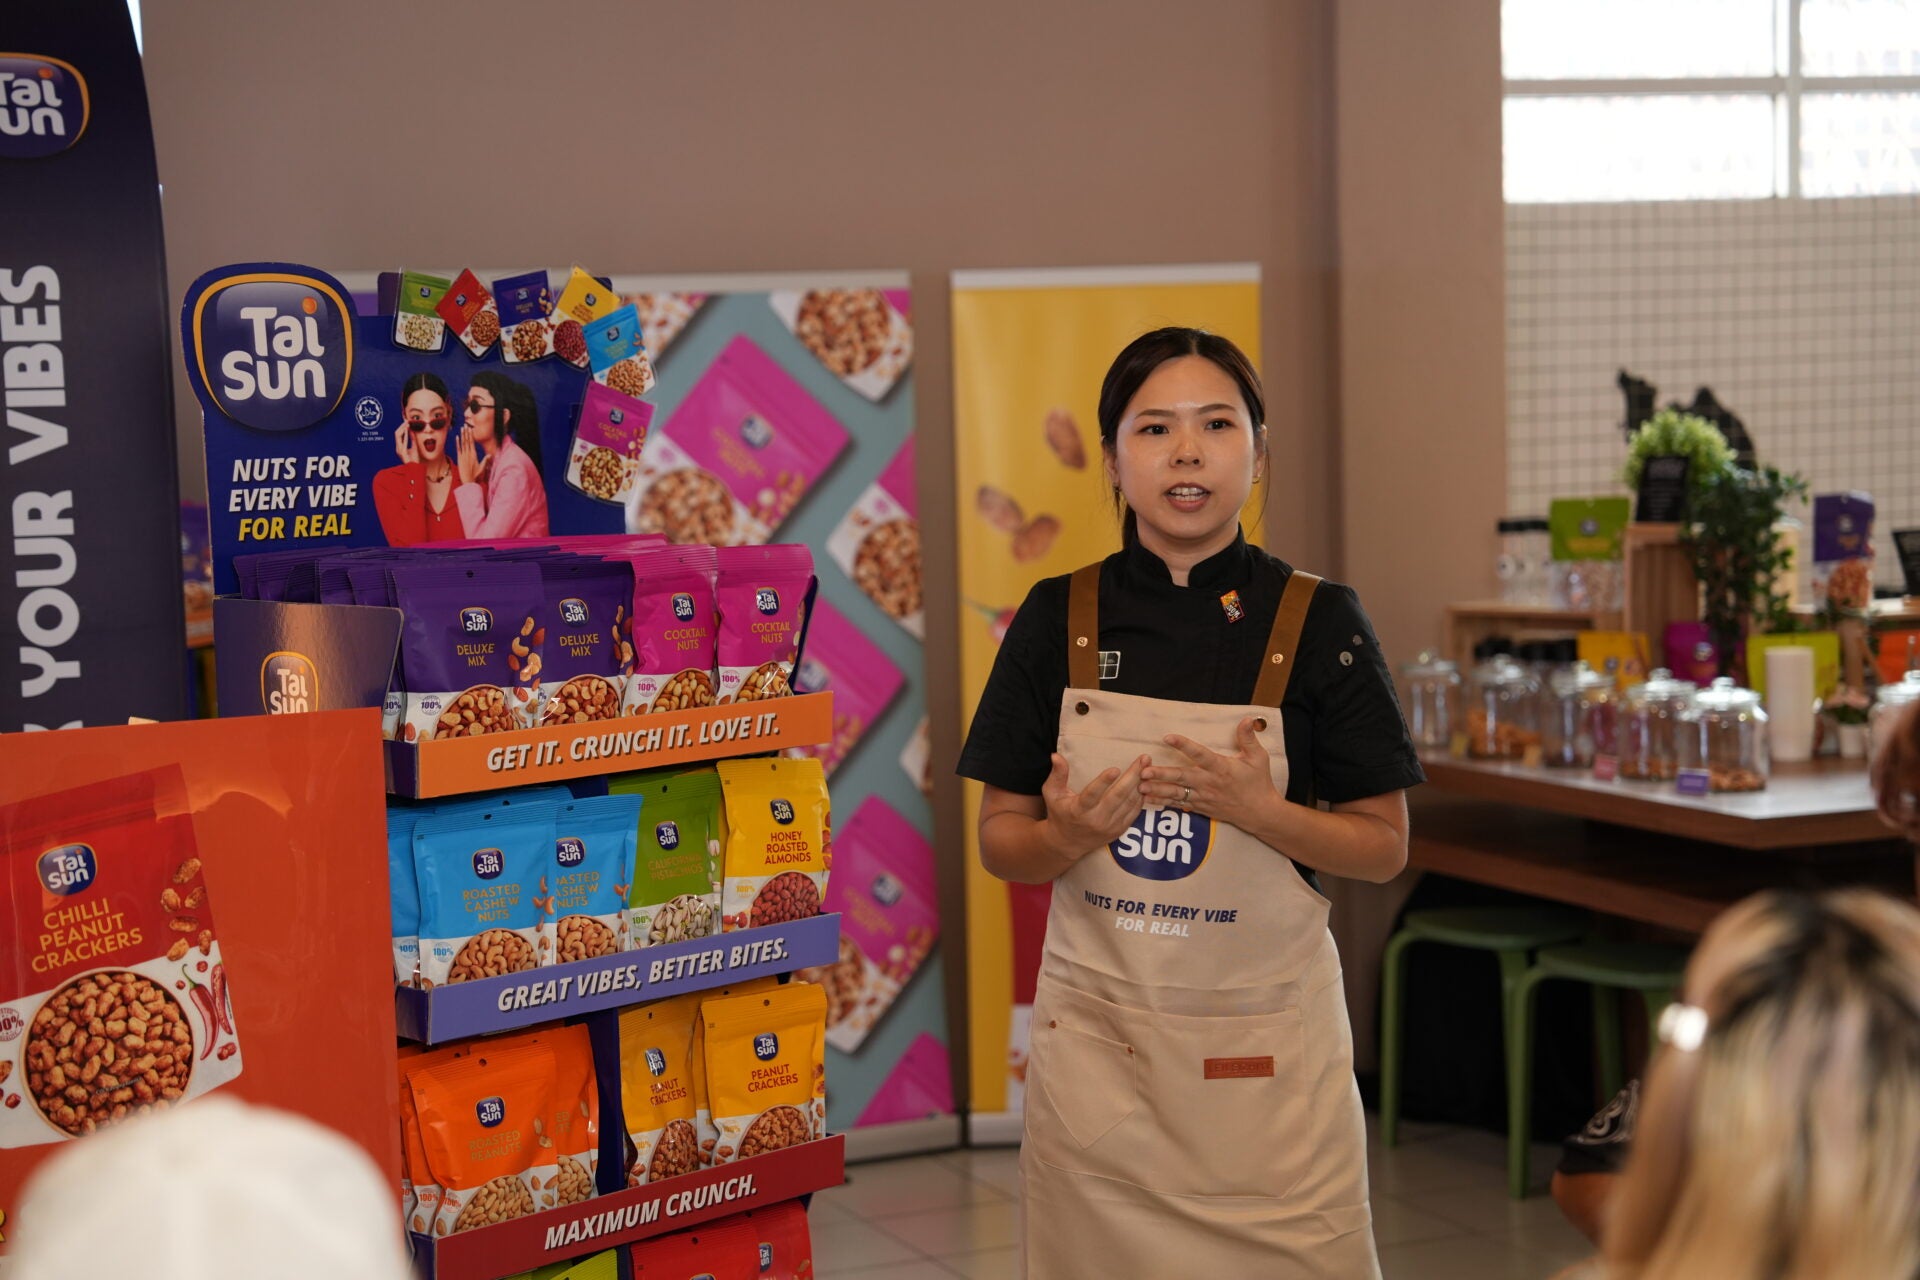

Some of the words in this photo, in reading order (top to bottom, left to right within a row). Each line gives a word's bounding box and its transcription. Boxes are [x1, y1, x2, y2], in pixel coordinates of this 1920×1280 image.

[0, 107, 66, 136] un
[240, 296, 325, 358] Tai
[0, 265, 69, 466] VIBES
[221, 350, 326, 401] Sun
[232, 457, 297, 482] NUTS
[305, 455, 350, 479] FOR
[228, 486, 301, 512] EVERY
[308, 483, 358, 508] VIBE
[238, 518, 285, 541] FOR
[293, 513, 352, 538] REAL
[12, 490, 81, 698] YOUR
[761, 592, 775, 602] Tai
[567, 604, 584, 614] Tai
[677, 598, 691, 608] Tai
[759, 601, 777, 611] Sun
[469, 611, 488, 623] Tai
[565, 612, 585, 622] Sun
[675, 607, 693, 617] Sun
[466, 621, 488, 632] Sun
[751, 622, 791, 633] COCKTAIL
[559, 633, 600, 646] DELUXE
[664, 628, 708, 640] COCKTAIL
[761, 633, 783, 644] NUTS
[457, 643, 495, 656] DELUXE
[677, 639, 699, 650] NUTS
[571, 646, 592, 657] MIX
[468, 656, 487, 666] MIX
[276, 666, 308, 696] Tai
[722, 675, 740, 683] 100%
[638, 683, 657, 692] 100%
[270, 690, 309, 715] Sun
[421, 701, 442, 710] 100%
[487, 746, 535, 772] GET
[535, 742, 563, 765] IT.
[570, 726, 661, 762] CRUNCH
[667, 723, 693, 750] IT.
[699, 716, 750, 744] LOVE
[755, 712, 780, 738] IT.
[776, 802, 790, 812] Tai
[774, 811, 792, 820] Sun
[1140, 803, 1194, 838] Tai
[662, 825, 675, 836] Tai
[770, 831, 802, 842] HONEY
[660, 834, 677, 845] Sun
[1117, 827, 1192, 864] Sun
[562, 841, 579, 853] Tai
[766, 842, 808, 853] ROASTED
[53, 849, 87, 872] Tai
[481, 852, 498, 865] Tai
[558, 850, 581, 862] Sun
[764, 852, 811, 865] ALMONDS
[477, 863, 499, 875] Sun
[48, 867, 89, 889] Sun
[463, 883, 521, 900] ROASTED
[465, 896, 520, 913] CASHEW
[1084, 890, 1112, 909] NUTS
[1116, 899, 1146, 915] FOR
[1151, 903, 1200, 921] EVERY
[1204, 909, 1238, 923] VIBE
[43, 897, 110, 930] CHILLI
[478, 910, 510, 922] NUTS
[39, 913, 124, 952] PEANUT
[1115, 916, 1145, 933] FOR
[1150, 921, 1189, 937] REAL
[32, 928, 143, 973] CRACKERS
[433, 947, 454, 956] 100%
[498, 981, 573, 1011] GREAT
[577, 964, 642, 998] VIBES,
[648, 949, 724, 983] BETTER
[728, 937, 789, 968] BITES.
[759, 1035, 774, 1047] Tai
[757, 1046, 776, 1056] Sun
[751, 1064, 790, 1080] PEANUT
[747, 1074, 799, 1093] CRACKERS
[484, 1101, 500, 1113] Tai
[481, 1111, 501, 1123] Sun
[469, 1131, 521, 1150] ROASTED
[544, 1199, 661, 1250] MAXIMUM
[665, 1174, 757, 1217] CRUNCH.
